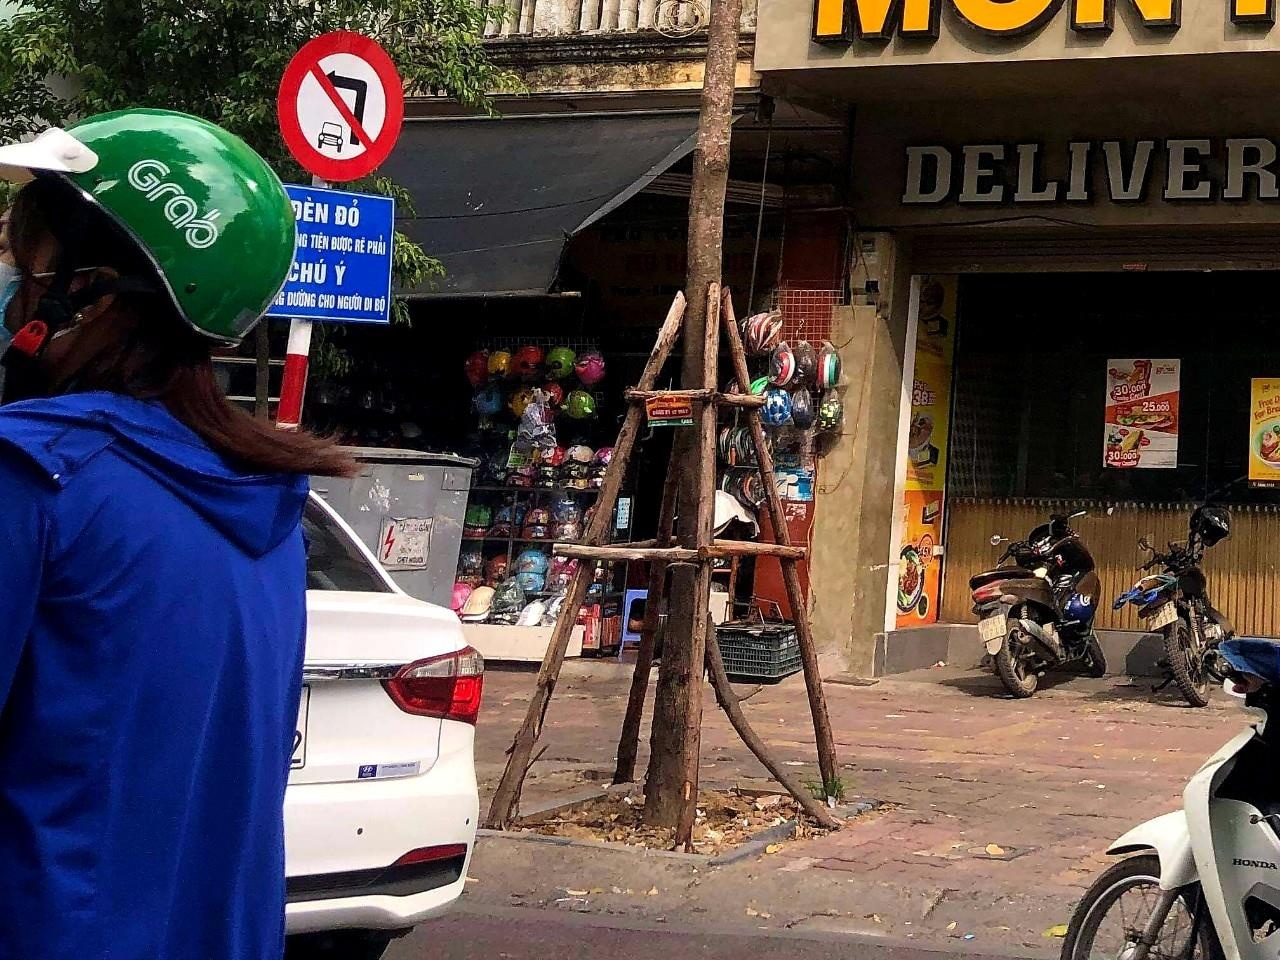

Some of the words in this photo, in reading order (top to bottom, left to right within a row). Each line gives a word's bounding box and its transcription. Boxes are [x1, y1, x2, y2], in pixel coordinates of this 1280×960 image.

[128, 159, 218, 249] Grab
[335, 199, 360, 227] ĐỎ
[288, 258, 327, 284] CHÚ
[335, 260, 346, 285] Ý
[318, 293, 335, 309] CHO
[1232, 858, 1278, 870] HONDA
